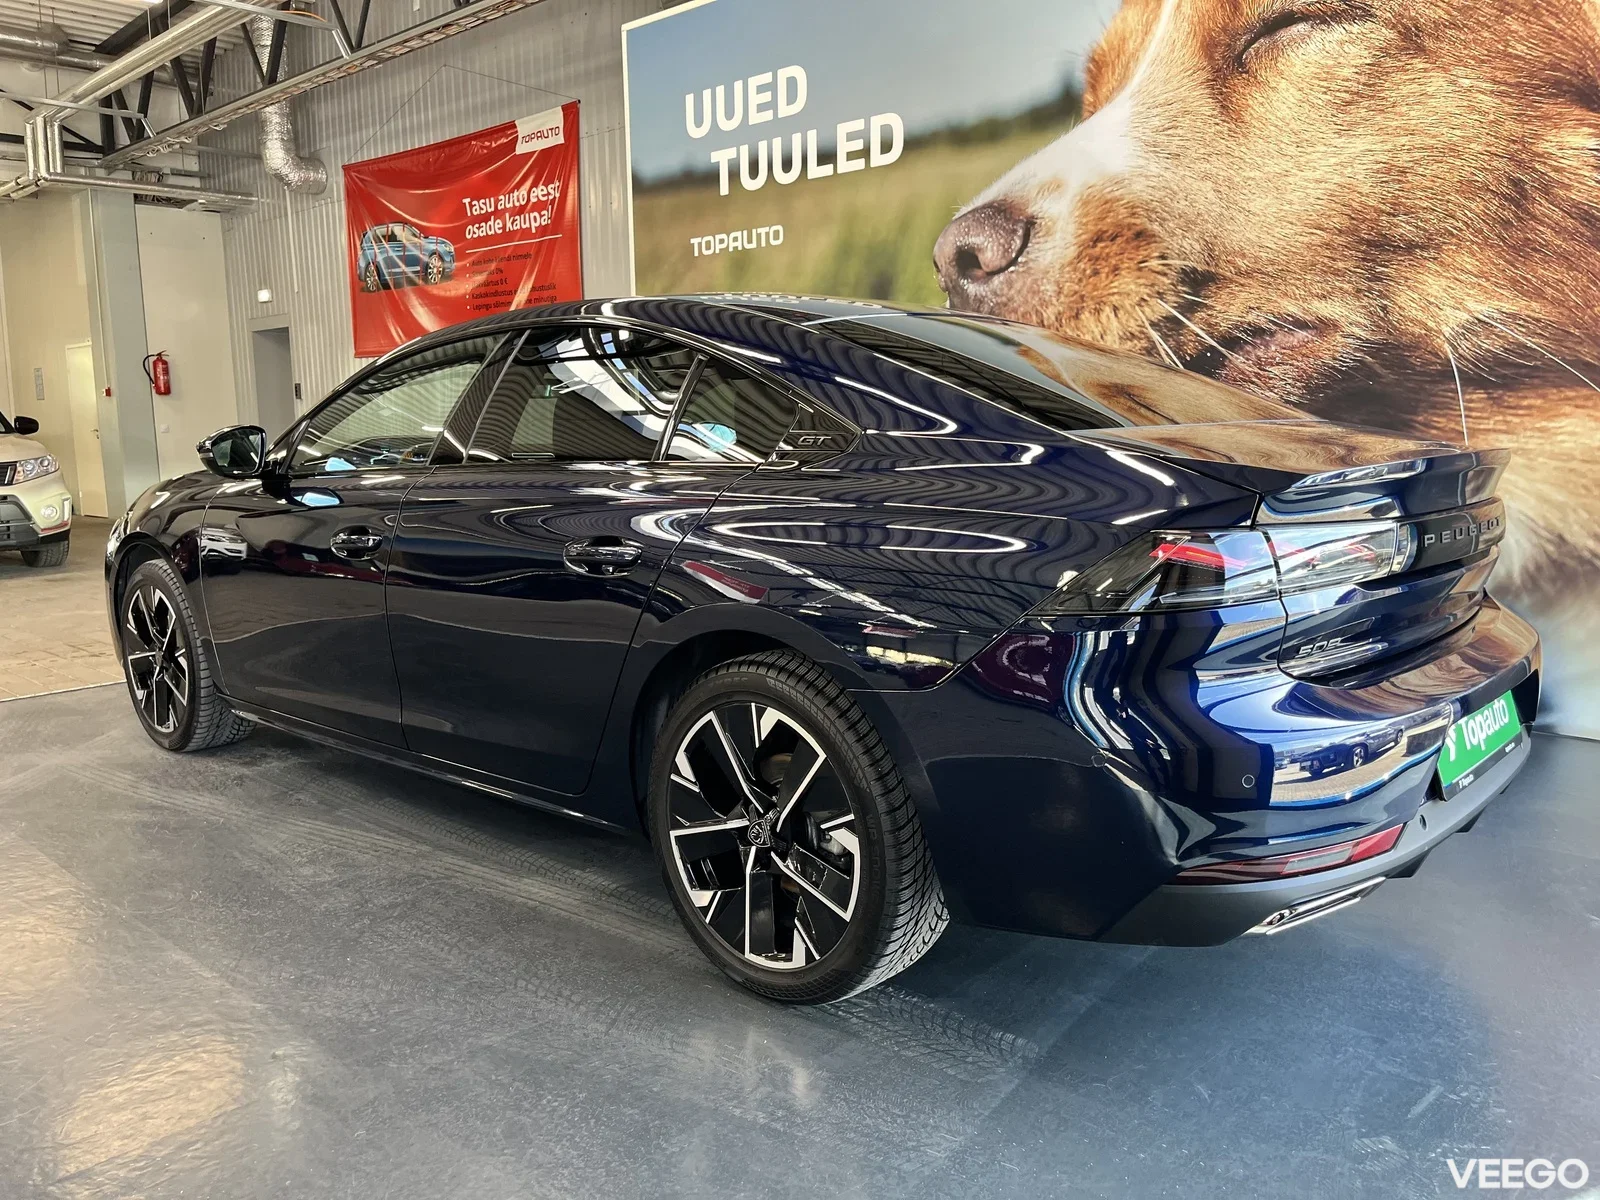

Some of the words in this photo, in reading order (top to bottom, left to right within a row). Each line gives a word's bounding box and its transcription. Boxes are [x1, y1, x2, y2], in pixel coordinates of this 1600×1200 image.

[685, 65, 807, 139] UUED
[521, 126, 560, 144] TOPAUTO
[710, 112, 904, 196] TUULED
[462, 197, 495, 217] Tasu
[497, 188, 528, 208] auto
[529, 180, 560, 203] eest
[465, 216, 502, 239] osade
[505, 205, 551, 234] kaupa!
[690, 224, 784, 257] TOPAUTO
[797, 435, 832, 446] GT
[1422, 517, 1500, 547] PEUGEOT
[1458, 698, 1509, 751] Topauto
